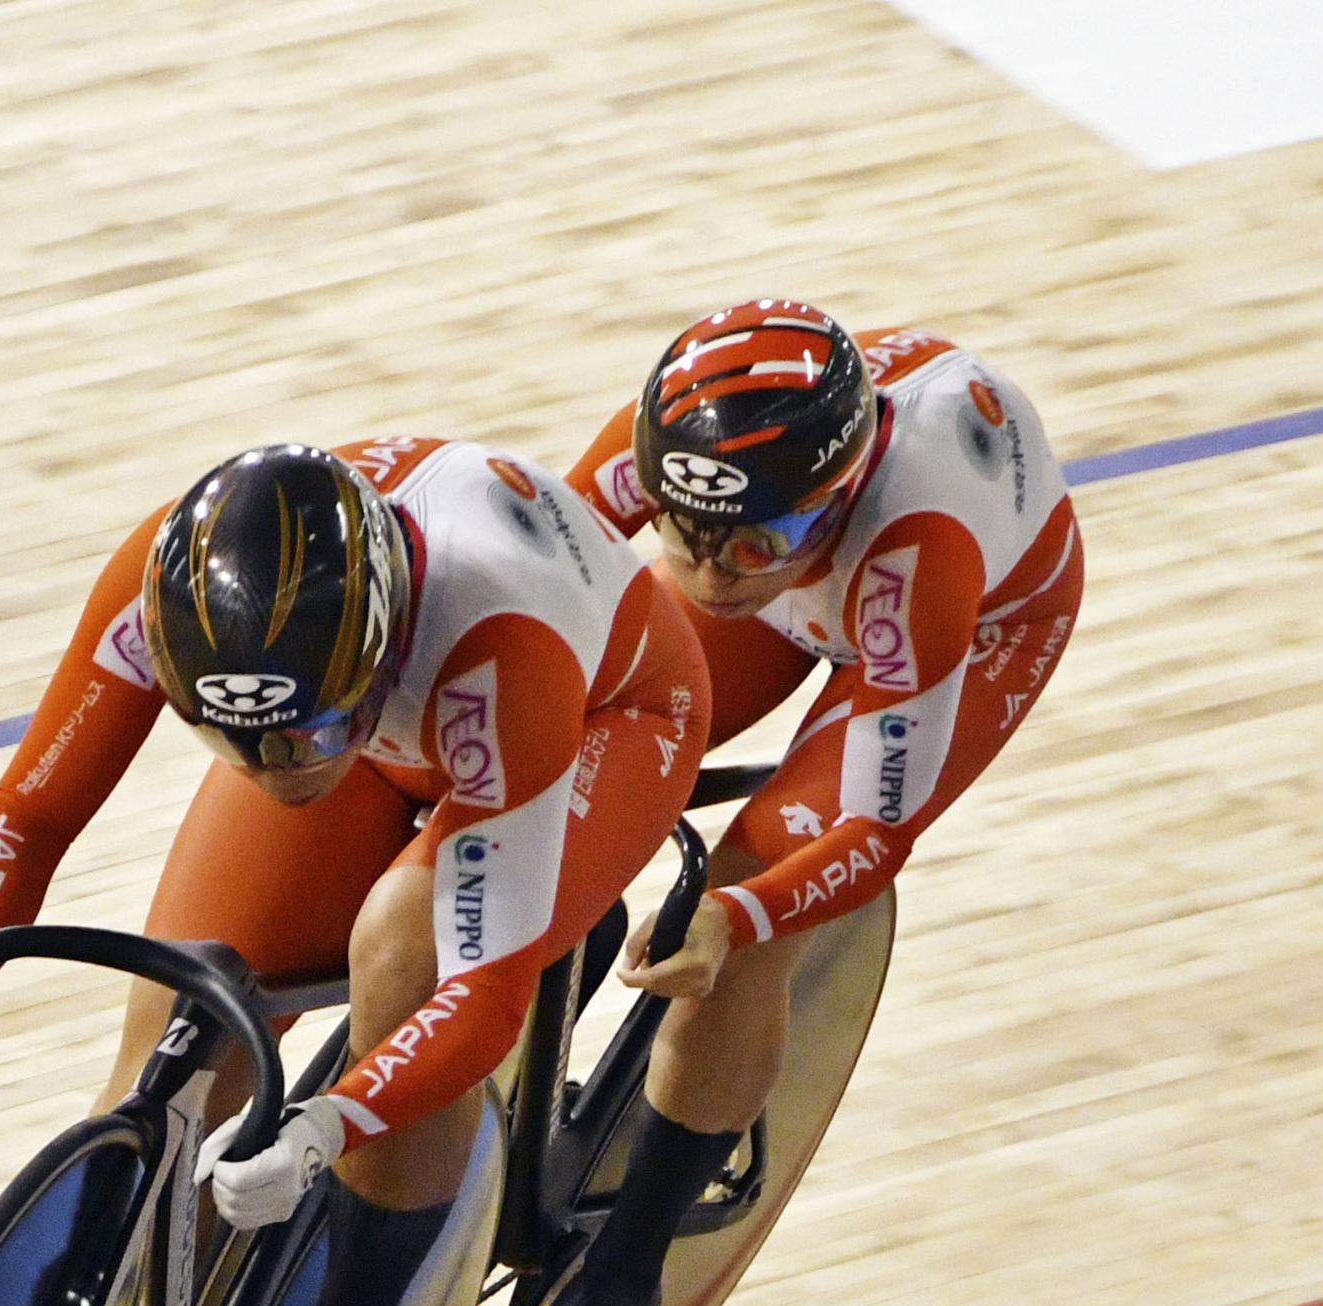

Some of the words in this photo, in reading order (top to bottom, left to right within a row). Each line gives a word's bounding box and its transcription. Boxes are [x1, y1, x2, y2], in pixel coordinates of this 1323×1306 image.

[660, 479, 743, 515] Kabuto
[201, 704, 299, 728] Kabuto
[878, 745, 908, 825] NIPPO
[456, 871, 486, 962] NIPPO
[362, 980, 473, 1100] JAPAN
